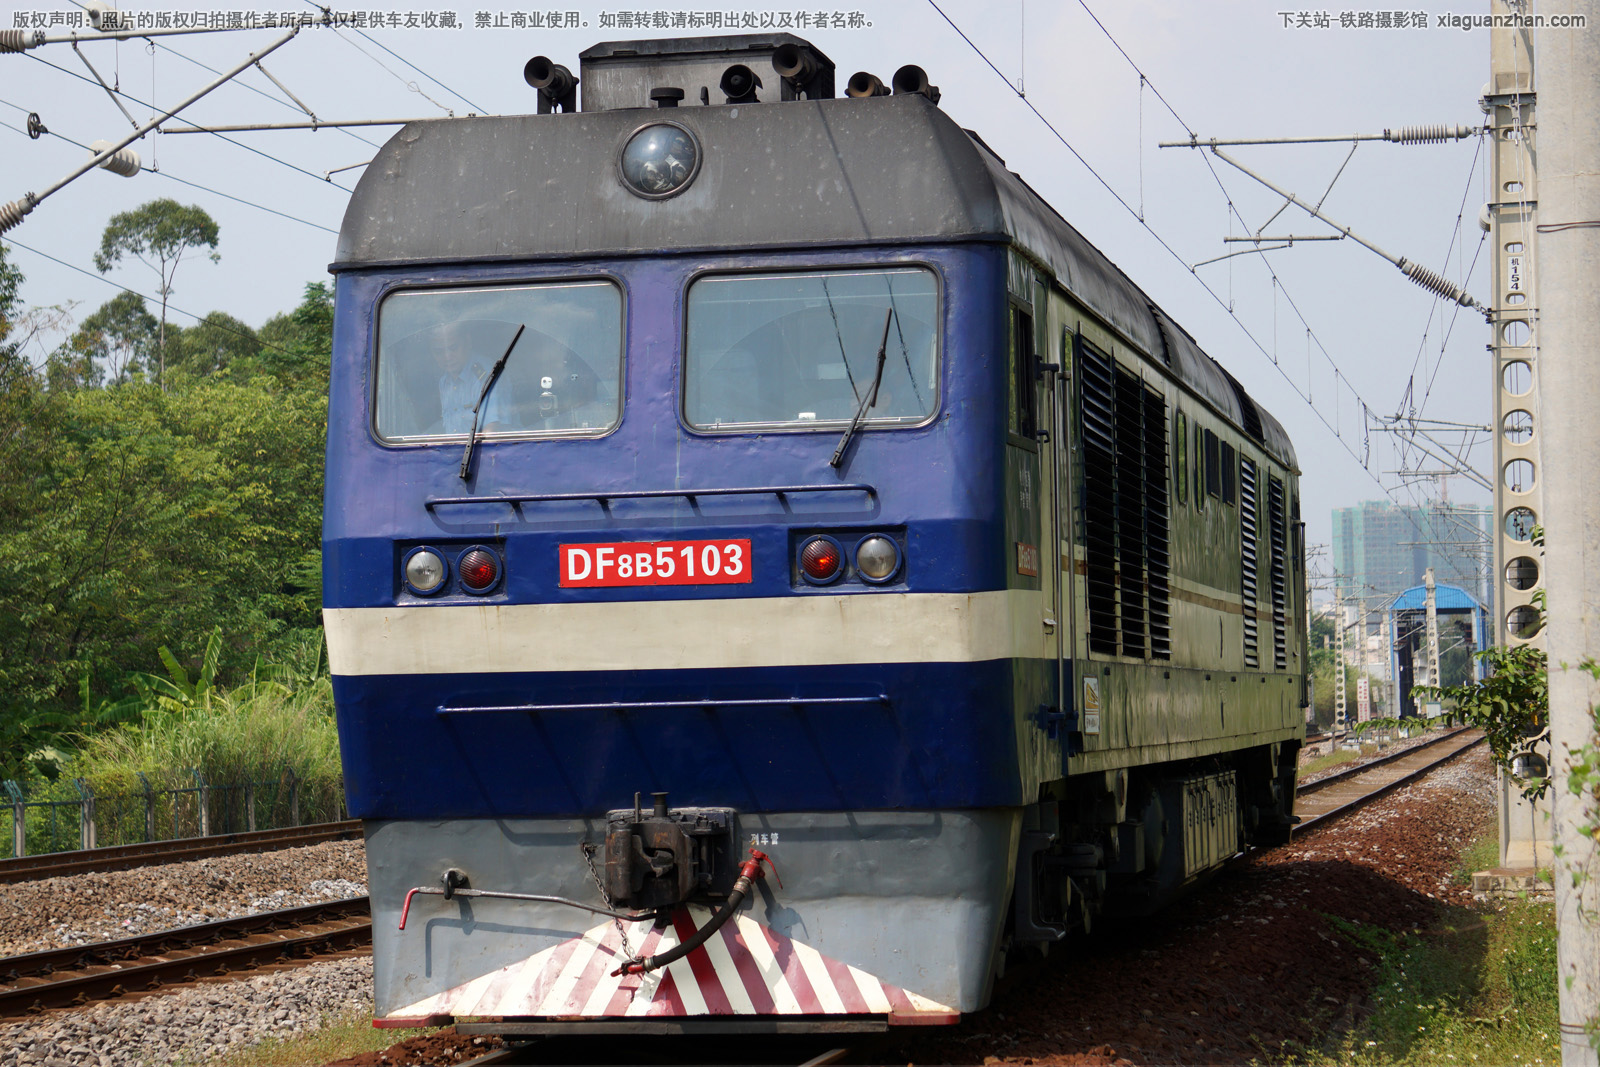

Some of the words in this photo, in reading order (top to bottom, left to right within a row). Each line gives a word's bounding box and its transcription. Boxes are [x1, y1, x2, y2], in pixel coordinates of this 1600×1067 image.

[567, 543, 743, 581] DF8B5103
[749, 832, 779, 846] 列车管
